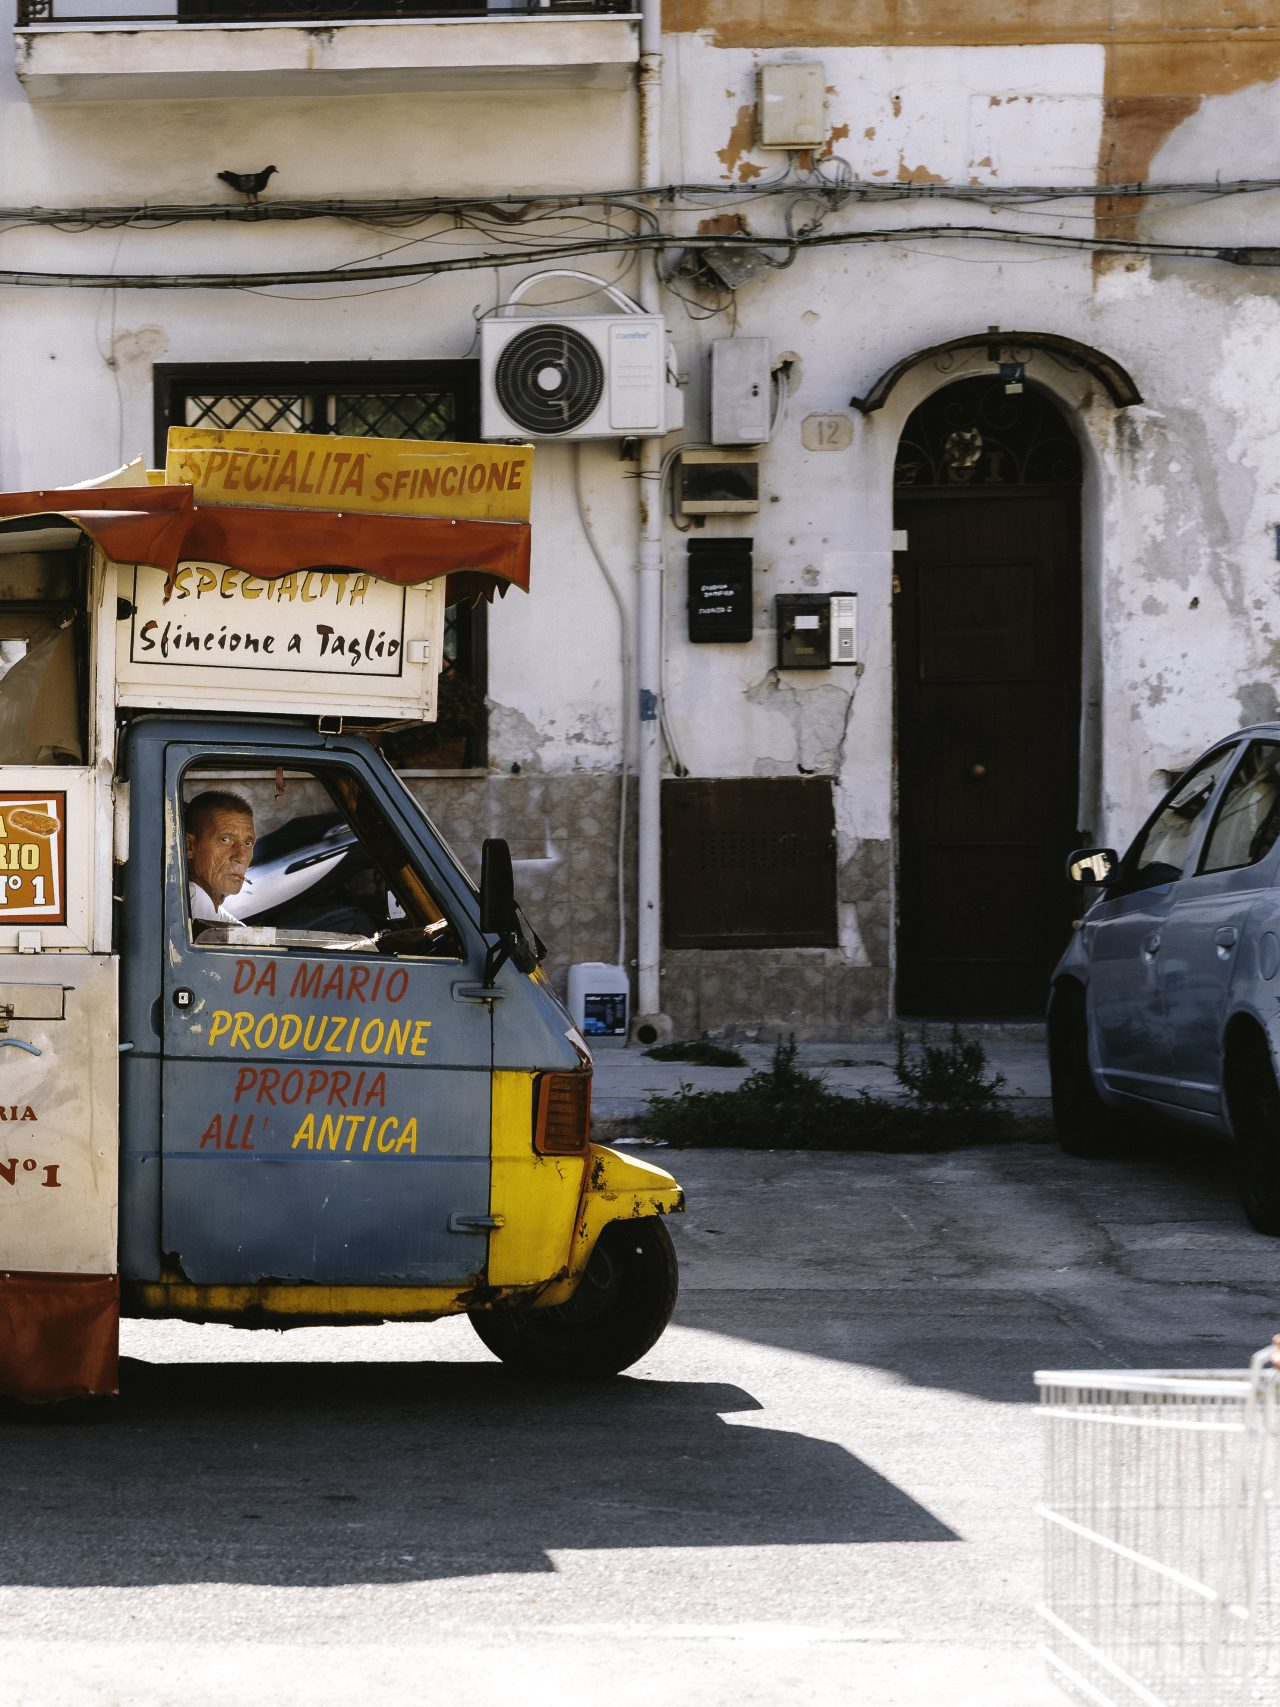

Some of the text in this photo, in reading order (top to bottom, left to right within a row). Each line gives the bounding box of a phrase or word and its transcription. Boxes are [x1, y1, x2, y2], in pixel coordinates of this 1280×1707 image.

[816, 420, 841, 446] 12
[371, 459, 526, 503] SFINCIONE
[139, 620, 401, 667] Sfincione a Taglio
[232, 959, 409, 1003] DA MARIO
[208, 1010, 432, 1057] PRODUZIONE
[233, 1066, 387, 1107] PROPRIA
[291, 1112, 418, 1154] ANTICA
